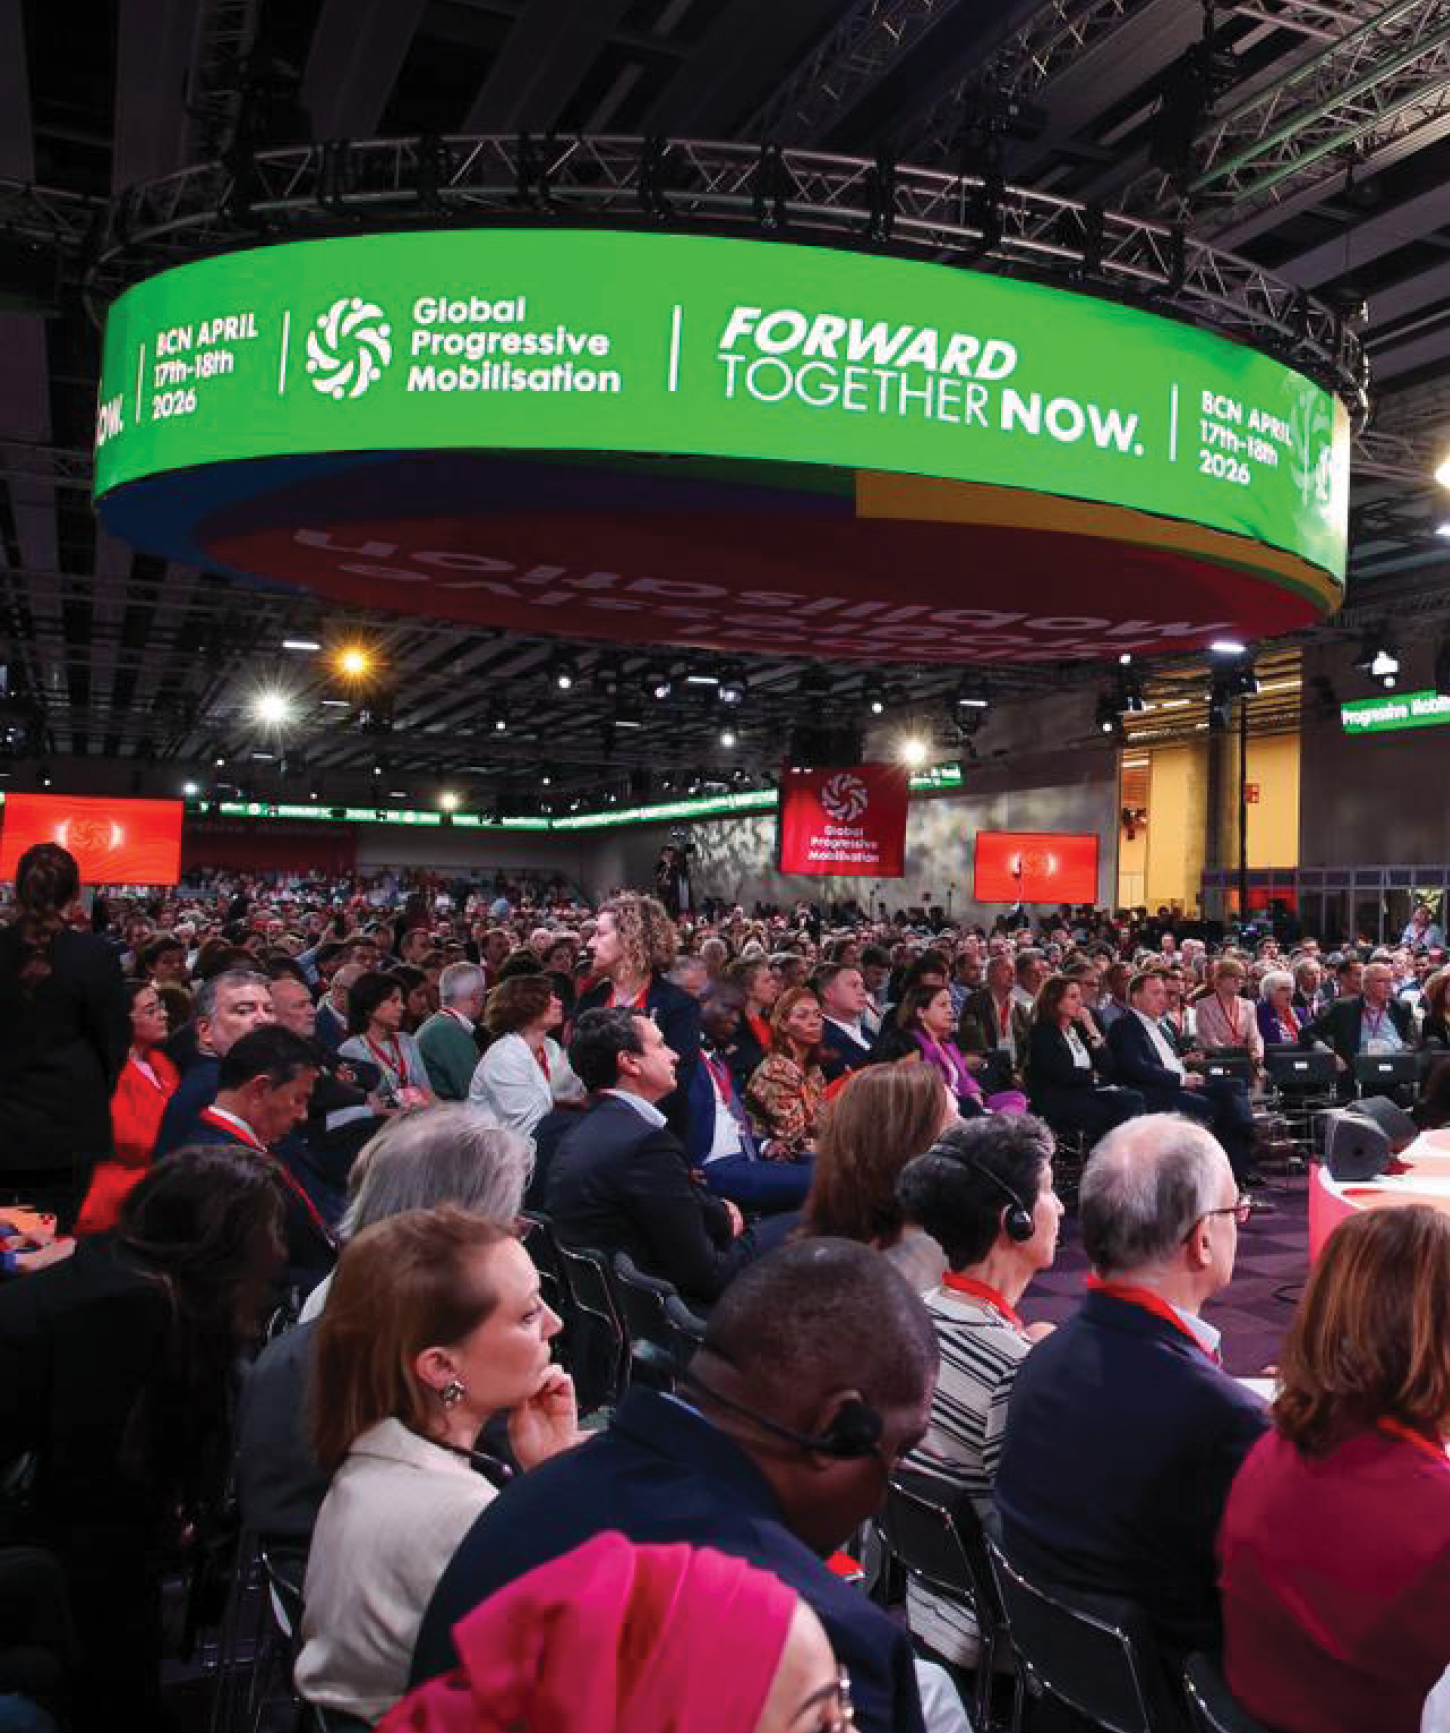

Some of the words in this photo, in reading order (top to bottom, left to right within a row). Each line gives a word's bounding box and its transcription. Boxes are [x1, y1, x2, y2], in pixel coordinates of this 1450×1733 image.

[412, 296, 526, 325] Global
[156, 325, 193, 357] BCN
[197, 312, 259, 346] APRIL
[411, 324, 611, 360] Progressive
[719, 306, 1018, 380] FORWARD
[154, 350, 235, 389] 17th-18th
[407, 360, 624, 393] Mobilisation
[95, 392, 124, 446] OW.
[152, 387, 198, 422] 2026
[718, 354, 989, 428] TOGETHER
[1000, 388, 1145, 457] NOW.
[1202, 390, 1242, 425] BCN
[1248, 408, 1293, 447] APRIL
[1200, 418, 1279, 469] 17th-18th
[1199, 449, 1251, 487] 2026
